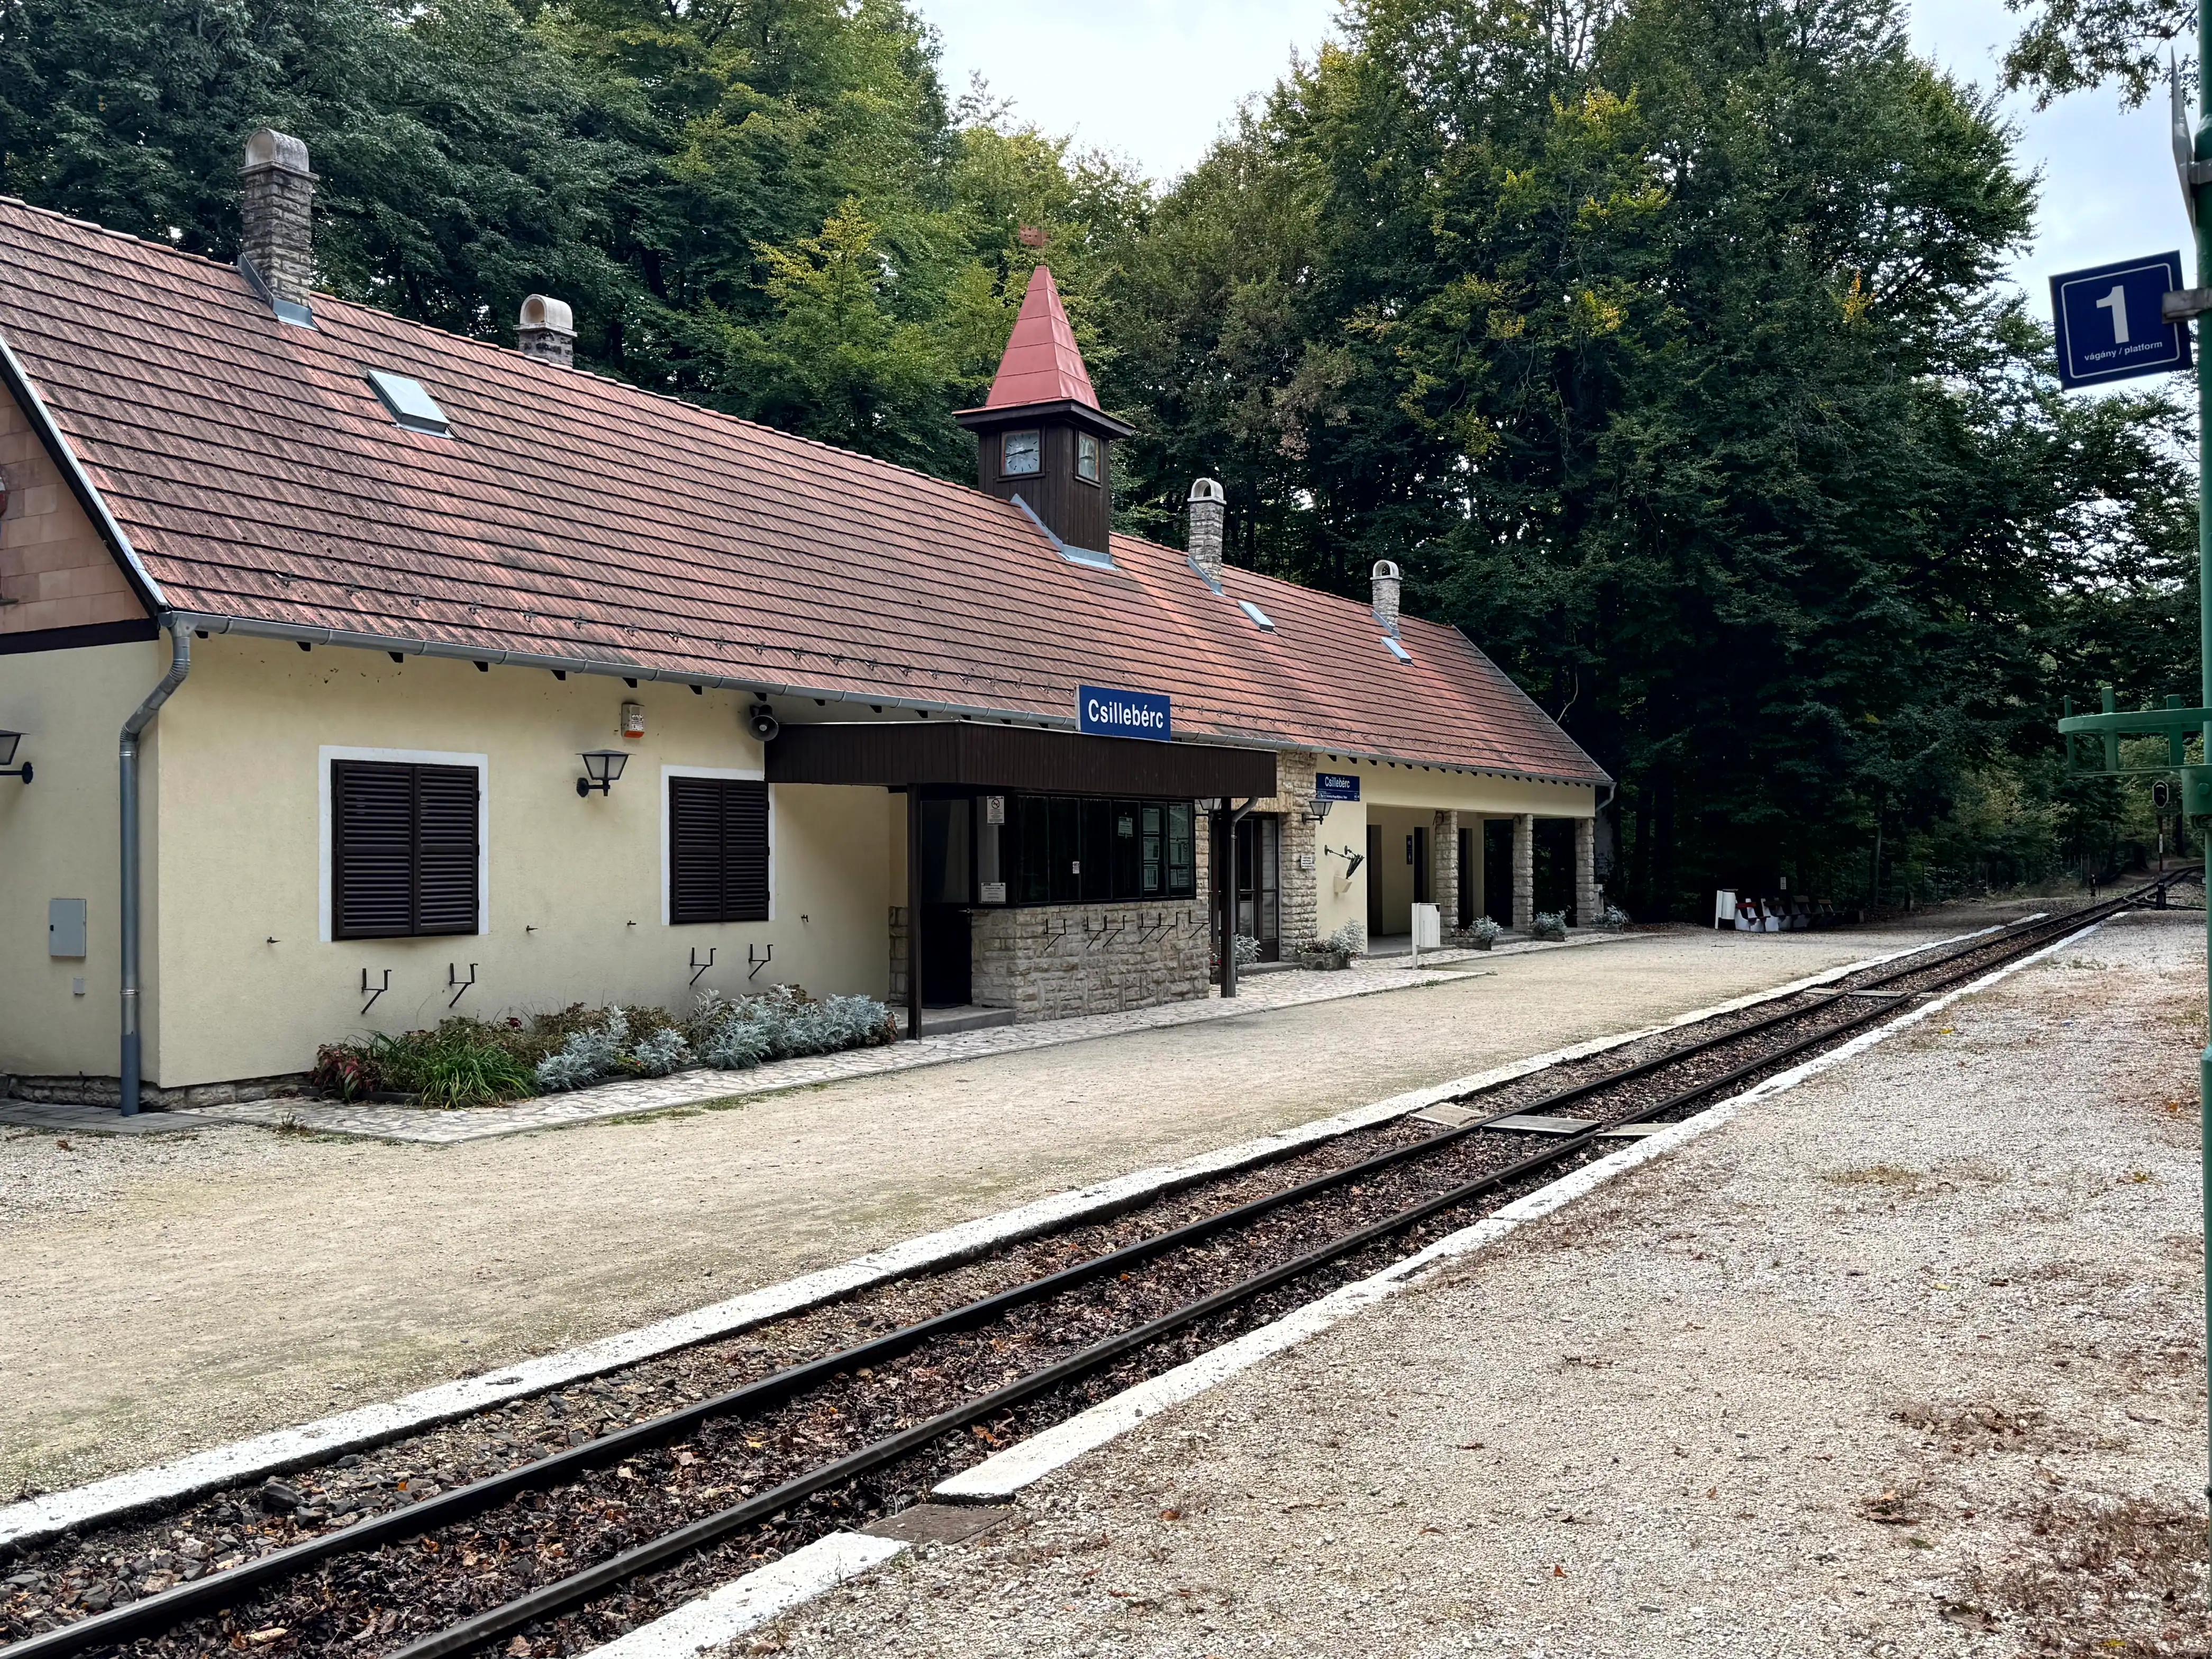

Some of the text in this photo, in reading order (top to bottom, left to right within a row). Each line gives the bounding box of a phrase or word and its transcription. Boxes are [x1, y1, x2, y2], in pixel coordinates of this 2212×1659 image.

[2096, 285, 2129, 344] 1
[2084, 350, 2116, 361] vágány
[2124, 342, 2163, 355] platform
[1088, 699, 1163, 728] Csillebérc
[1325, 776, 1350, 788] Csillebérc
